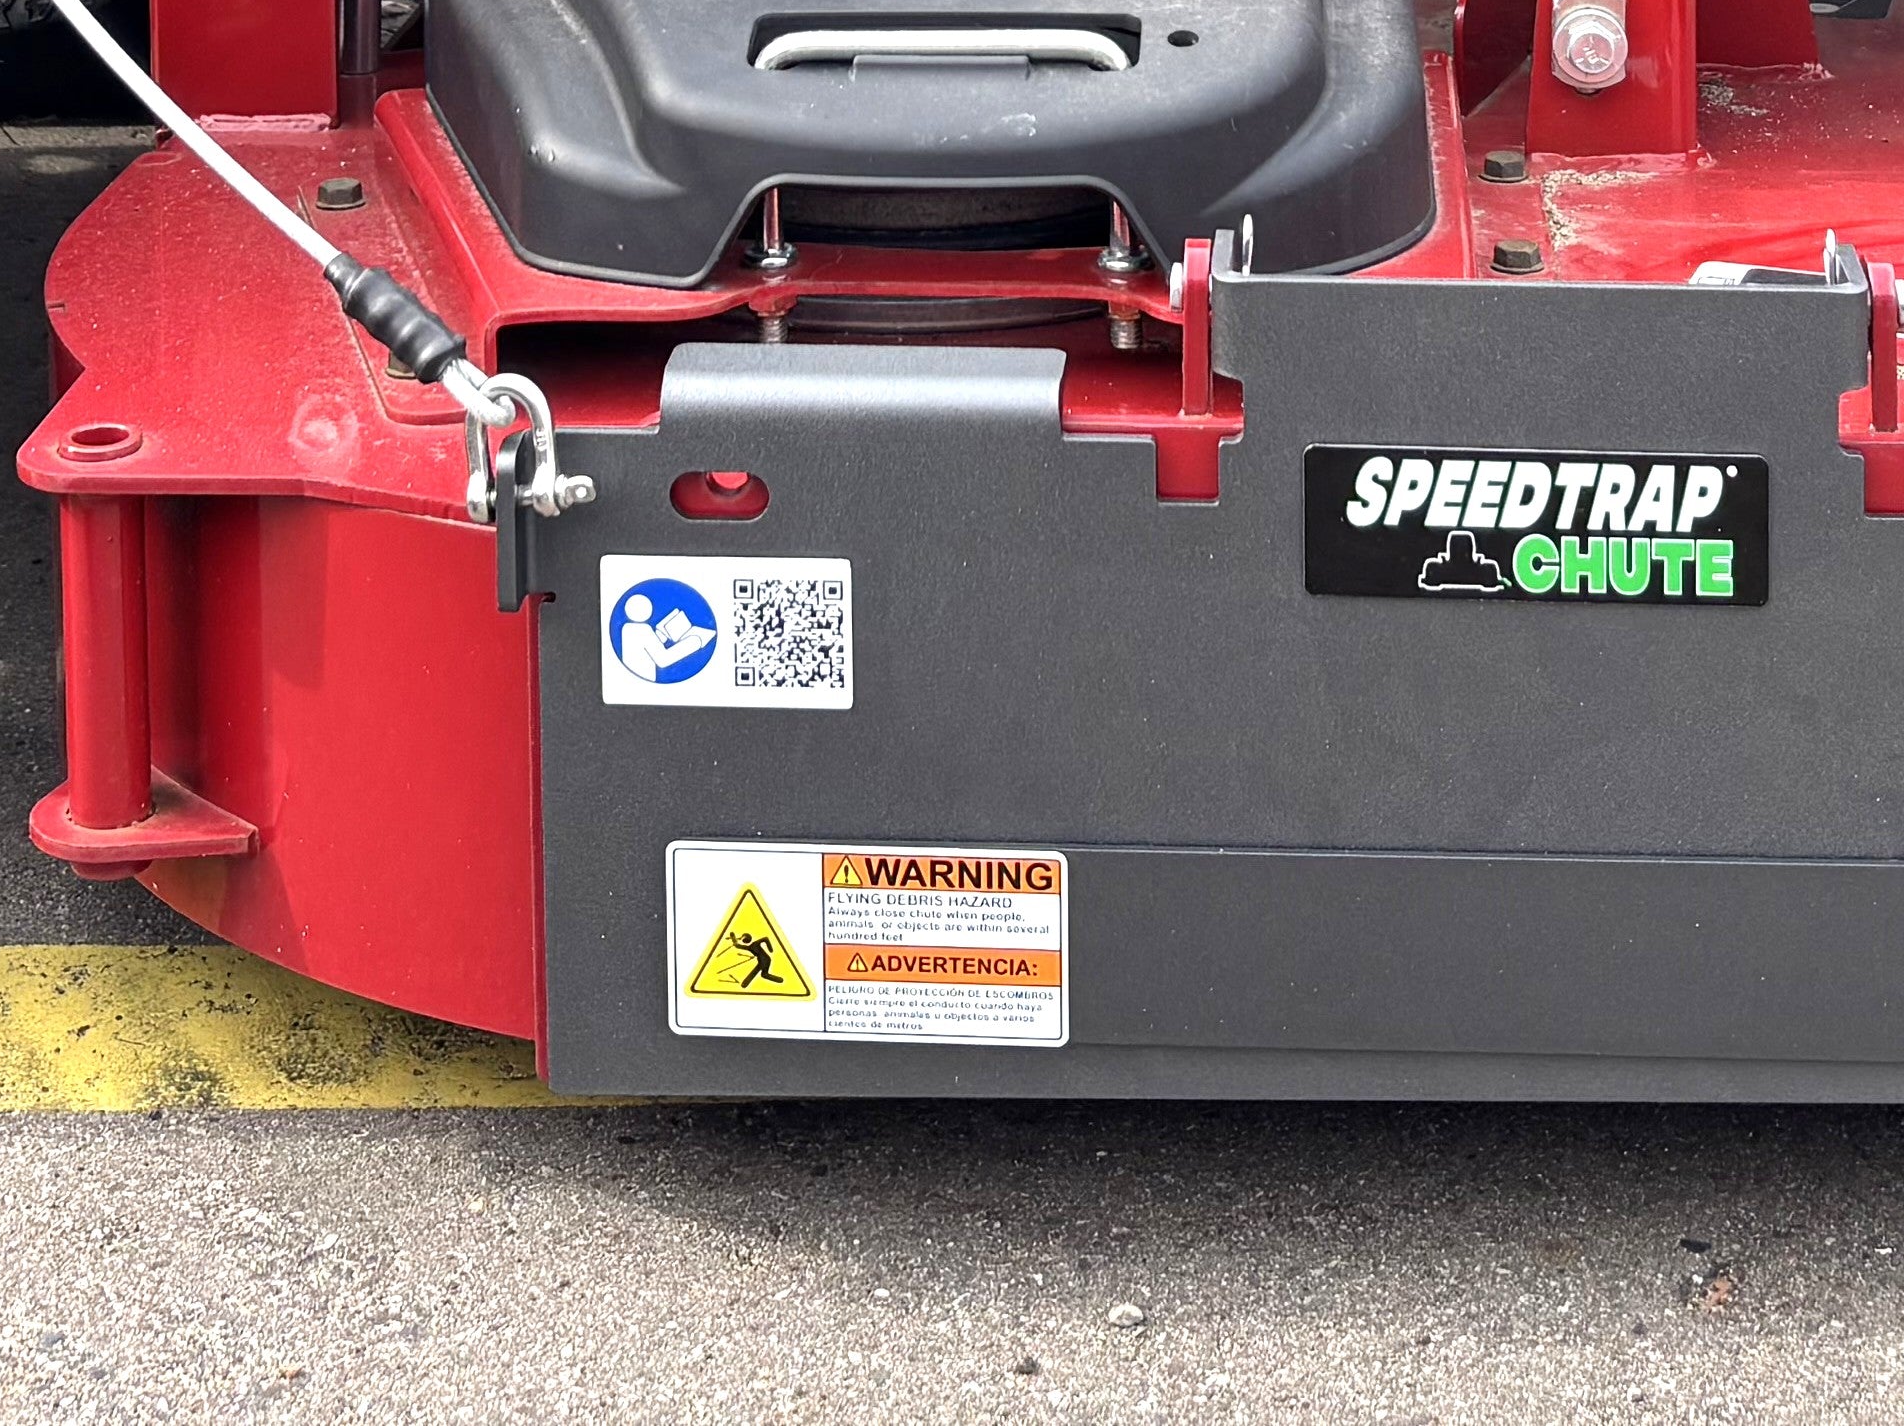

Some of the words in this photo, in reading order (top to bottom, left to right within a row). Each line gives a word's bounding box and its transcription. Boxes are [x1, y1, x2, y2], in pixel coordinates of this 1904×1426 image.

[1346, 455, 1725, 533] SPEEDTRAP
[1512, 532, 1735, 598] CHUTE
[865, 857, 1053, 891] WARNING
[828, 892, 882, 905] FLYING
[886, 893, 944, 907] DEBRIS
[948, 896, 1013, 908] HAZARD
[828, 906, 870, 918] Always
[874, 908, 906, 918] close
[909, 909, 942, 919] chute
[946, 910, 978, 920] when
[881, 921, 893, 930] or
[897, 921, 941, 932] objects
[944, 923, 964, 932] are
[967, 924, 1003, 934] within
[1006, 925, 1051, 934] several
[828, 931, 878, 941] hundred
[870, 955, 1039, 977] ADVERTENCIA:
[828, 985, 875, 995] PELIGRO
[878, 986, 891, 996] DE
[895, 987, 965, 998] PROYECCIÓN
[968, 989, 981, 999] DE
[985, 990, 1054, 1001] ESCOMBROS
[864, 998, 905, 1008] siempre
[909, 1000, 919, 1008] el
[921, 1001, 971, 1010] conducto
[975, 1002, 1014, 1011] cuando
[1017, 1003, 1043, 1013] haya
[883, 1010, 931, 1019] animales
[1003, 1015, 1036, 1023] varios
[871, 1021, 883, 1029] de
